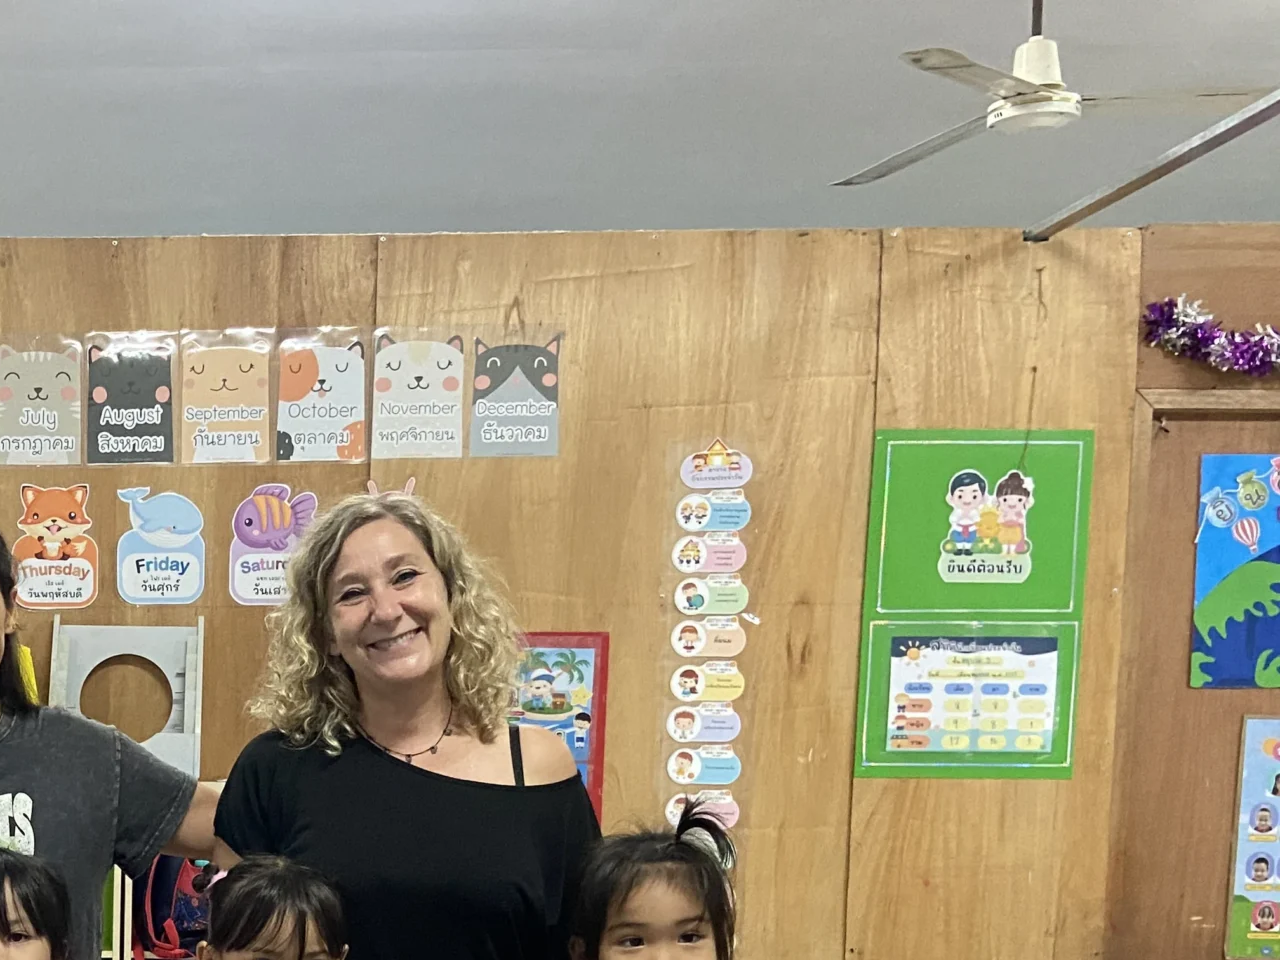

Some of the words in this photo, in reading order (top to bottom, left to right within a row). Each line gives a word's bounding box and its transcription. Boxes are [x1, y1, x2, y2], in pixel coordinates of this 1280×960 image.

[100, 406, 163, 428] August
[185, 406, 265, 426] September
[288, 402, 358, 419] October
[380, 401, 458, 416] November
[476, 401, 553, 416] December
[20, 409, 57, 430] July
[193, 428, 260, 446] กันยายน
[378, 425, 455, 445] พฤศจิกายน
[481, 422, 547, 440] ธันวาคม
[0, 436, 74, 455] กรกฎาคม
[99, 431, 164, 452] สิงหาคม
[293, 431, 350, 451] ตุลาคม
[20, 563, 90, 580] Thursday
[135, 556, 190, 576] Friday
[947, 559, 1023, 576] ยินดีต้อนรับ
[27, 588, 83, 600] วันพฤหัสบดี
[141, 579, 181, 597] วันศุกร์
